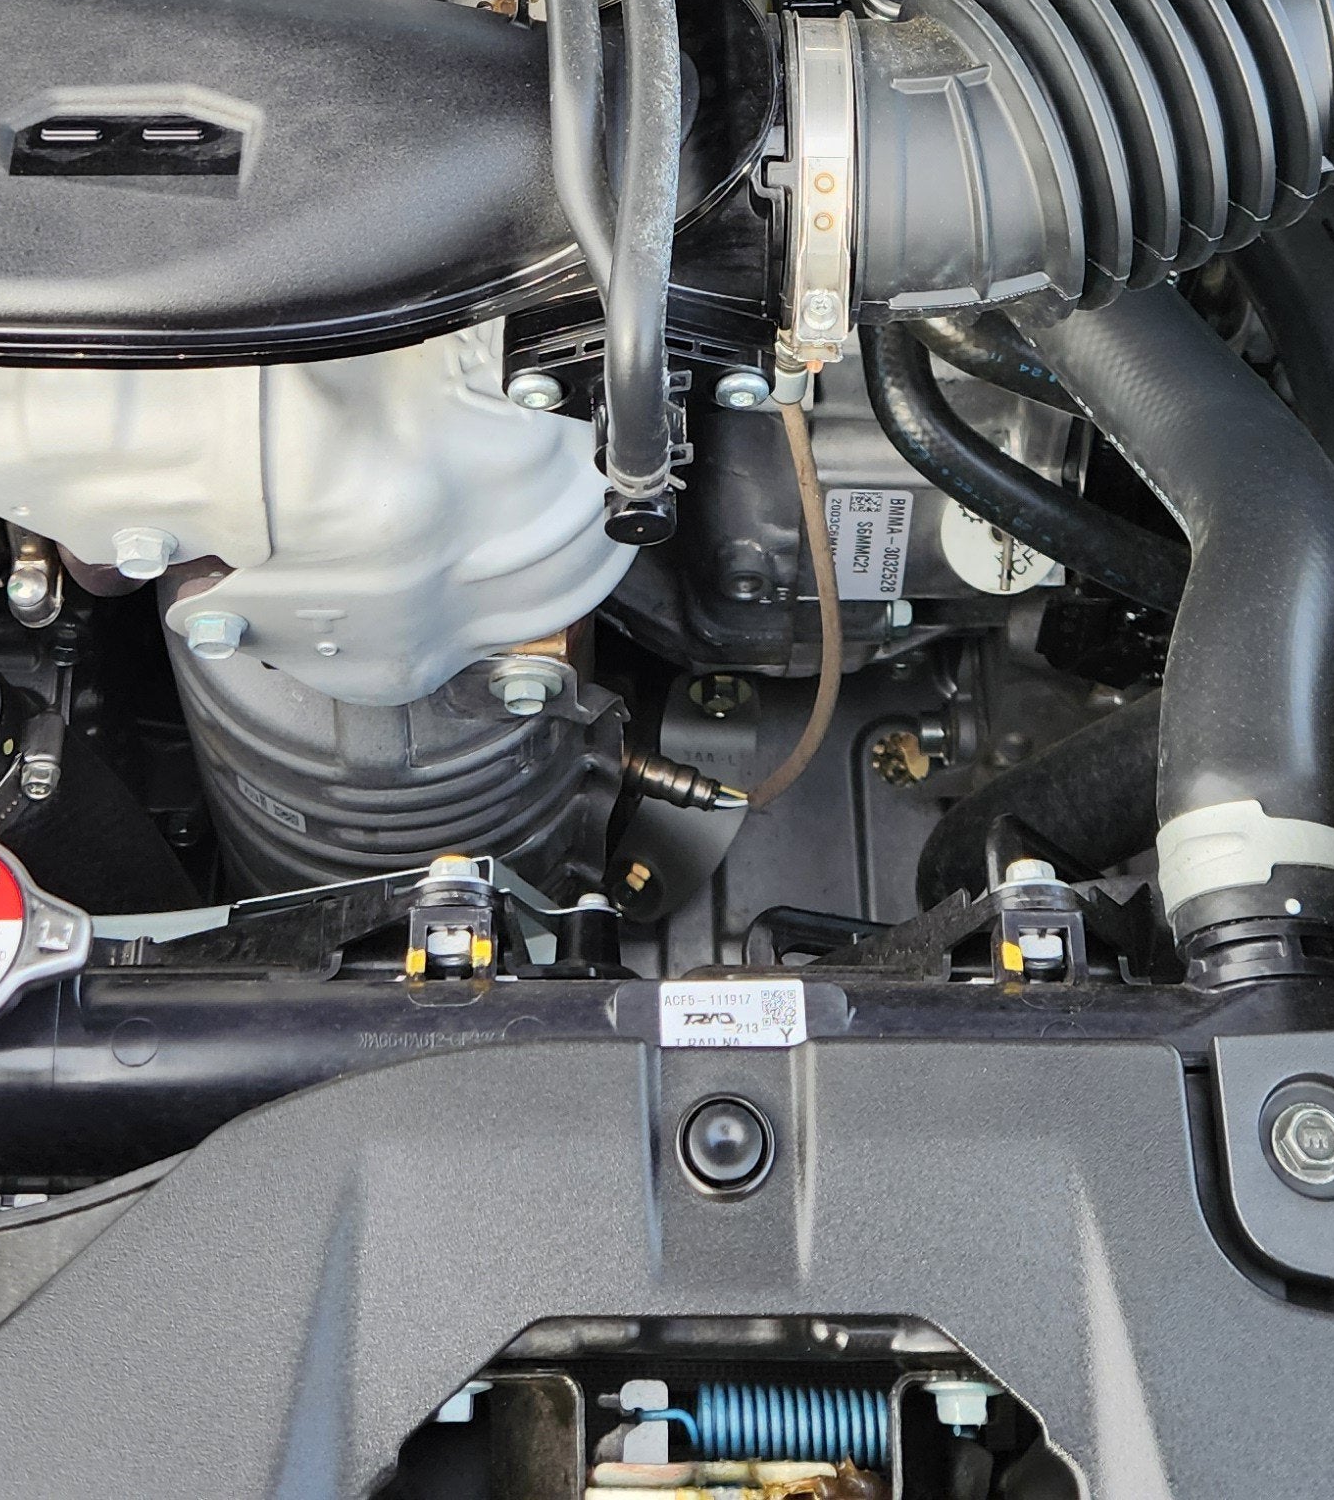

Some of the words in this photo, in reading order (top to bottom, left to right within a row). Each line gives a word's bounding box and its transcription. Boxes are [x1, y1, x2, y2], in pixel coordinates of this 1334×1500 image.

[853, 521, 874, 574] S6MMC21
[880, 498, 907, 593] BMMA-3032528
[664, 994, 752, 1006] ACF5-111917
[779, 1027, 794, 1043] Y
